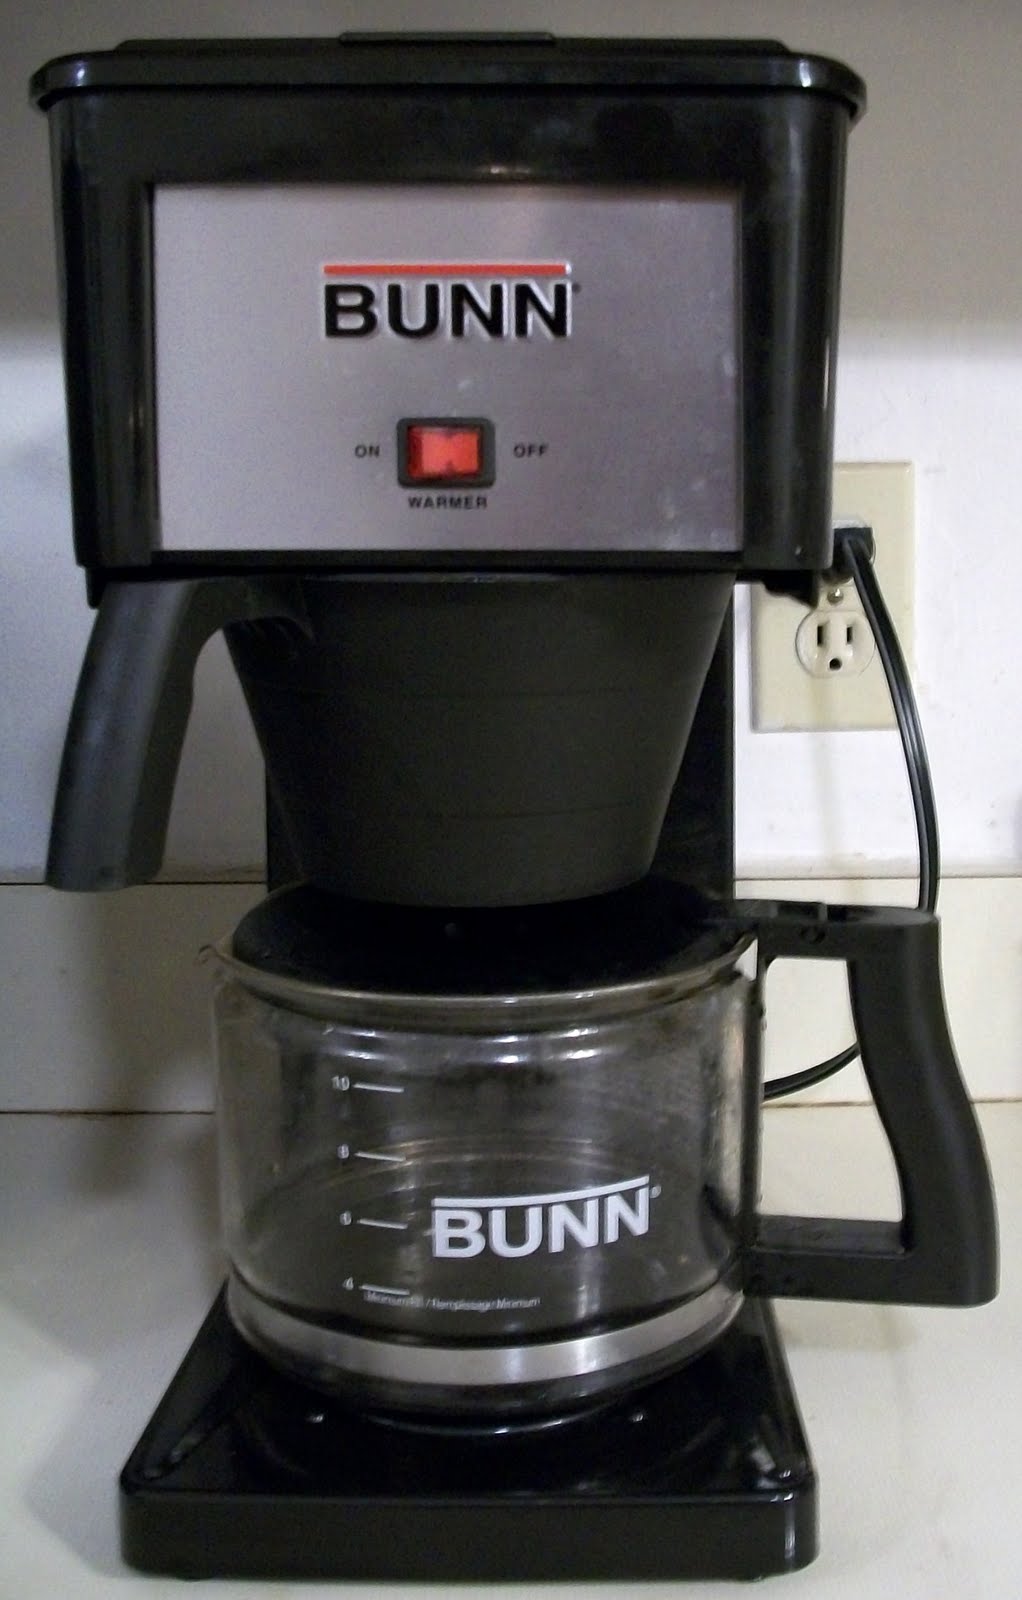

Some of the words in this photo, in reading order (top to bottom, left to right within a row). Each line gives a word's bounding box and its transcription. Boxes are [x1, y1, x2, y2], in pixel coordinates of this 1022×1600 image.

[324, 283, 568, 338] BUNN
[354, 445, 380, 458] ON
[513, 444, 548, 458] OFF
[408, 496, 488, 509] WARMER
[332, 1076, 349, 1091] 10
[432, 1186, 650, 1258] BUNN
